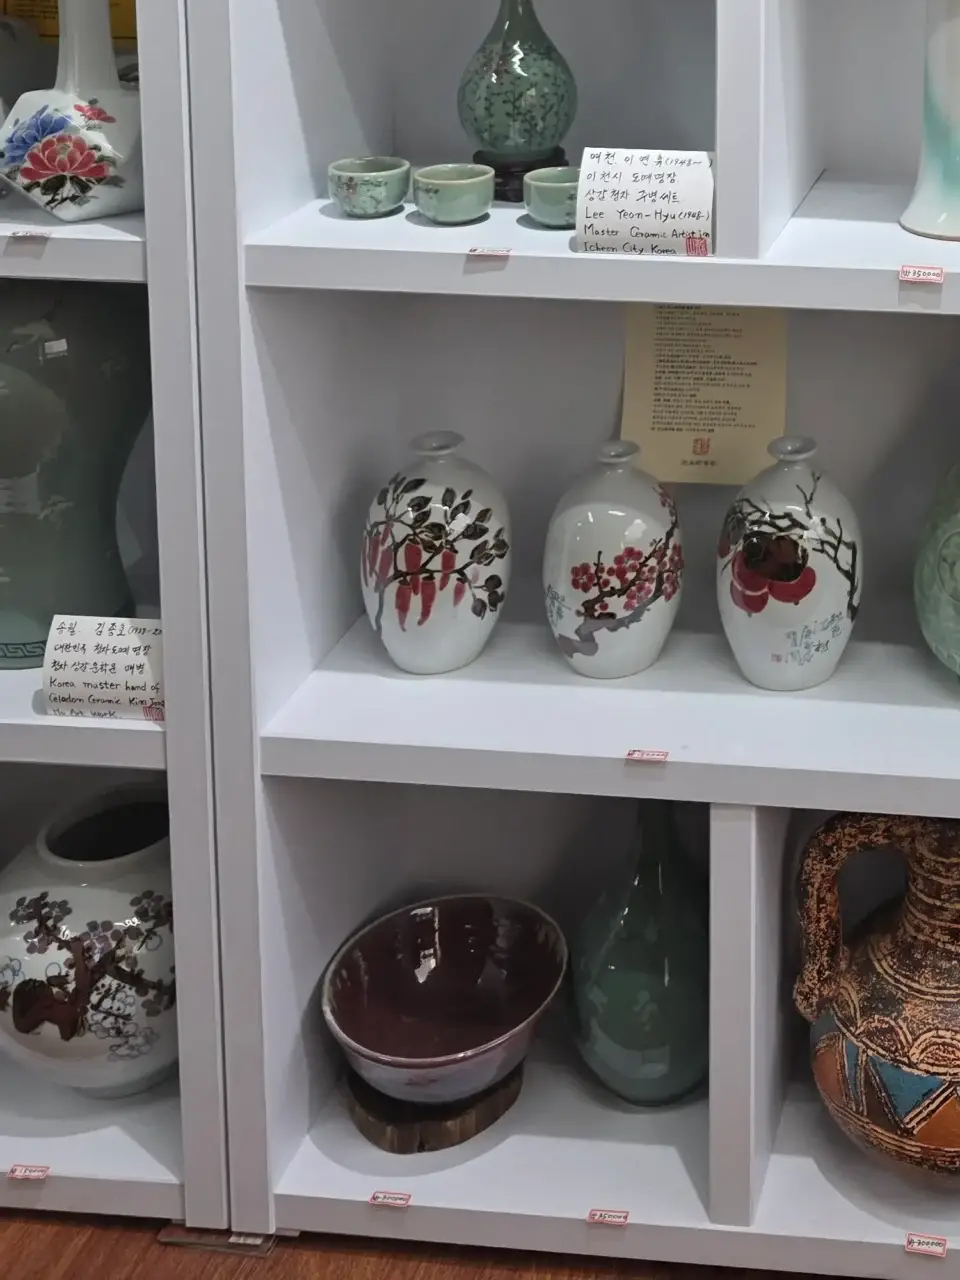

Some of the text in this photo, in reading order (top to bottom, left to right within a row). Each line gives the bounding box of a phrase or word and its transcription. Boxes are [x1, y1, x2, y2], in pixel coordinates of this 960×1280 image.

[587, 171, 622, 182] 이천시
[585, 206, 604, 219] Lee
[584, 224, 695, 238] Master Ceramic Artist
[622, 242, 644, 253] City
[54, 643, 86, 654] 대한민국
[49, 676, 76, 688] Korea
[126, 681, 147, 691] hand
[151, 683, 160, 693] of
